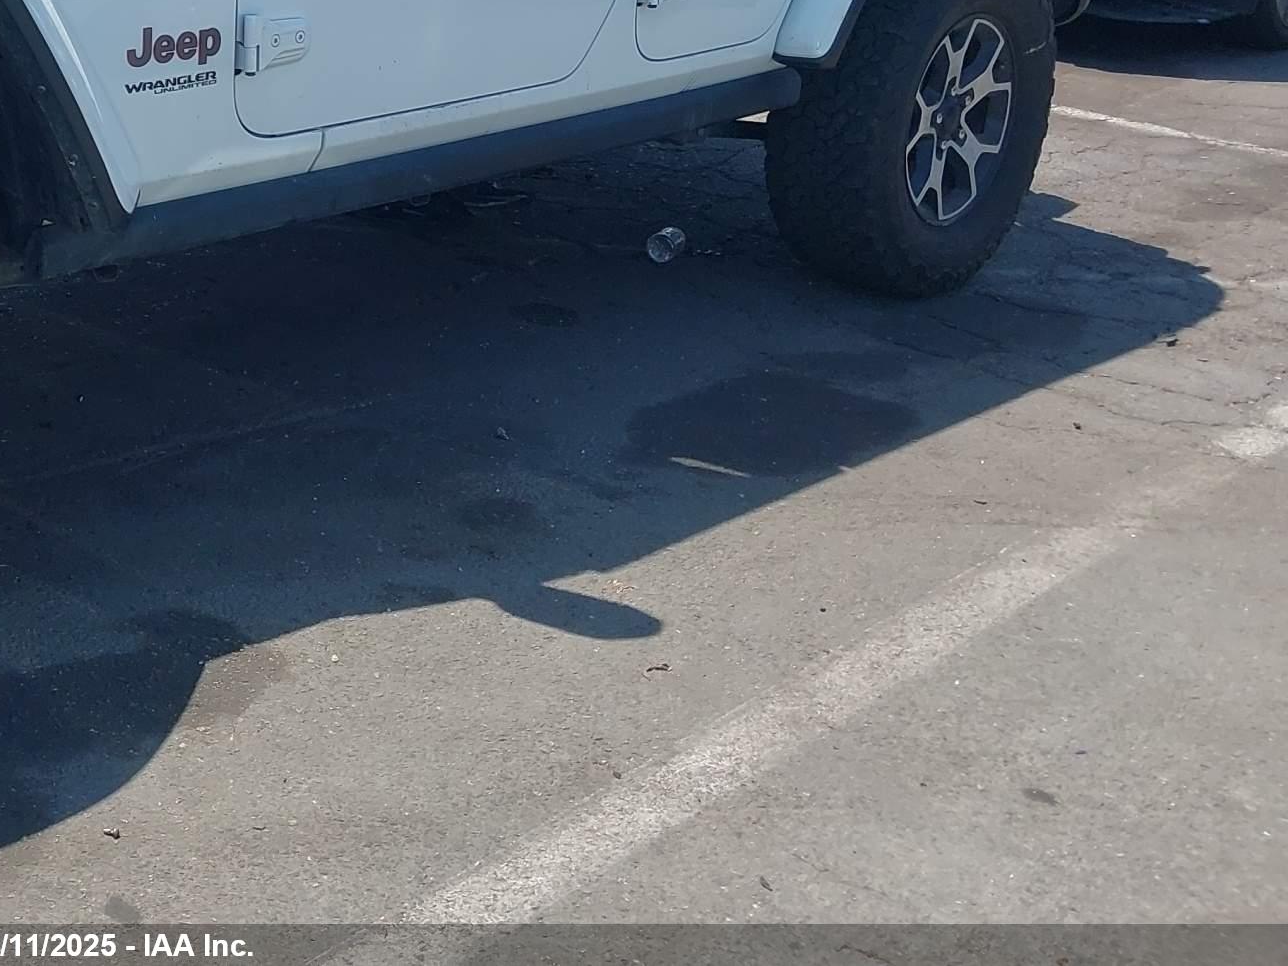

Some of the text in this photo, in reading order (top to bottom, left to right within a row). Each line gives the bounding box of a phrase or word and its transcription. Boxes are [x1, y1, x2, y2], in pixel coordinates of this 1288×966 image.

[125, 27, 222, 68] Jeep
[124, 70, 217, 94] WRANGLER
[153, 79, 217, 95] UNLIMITED
